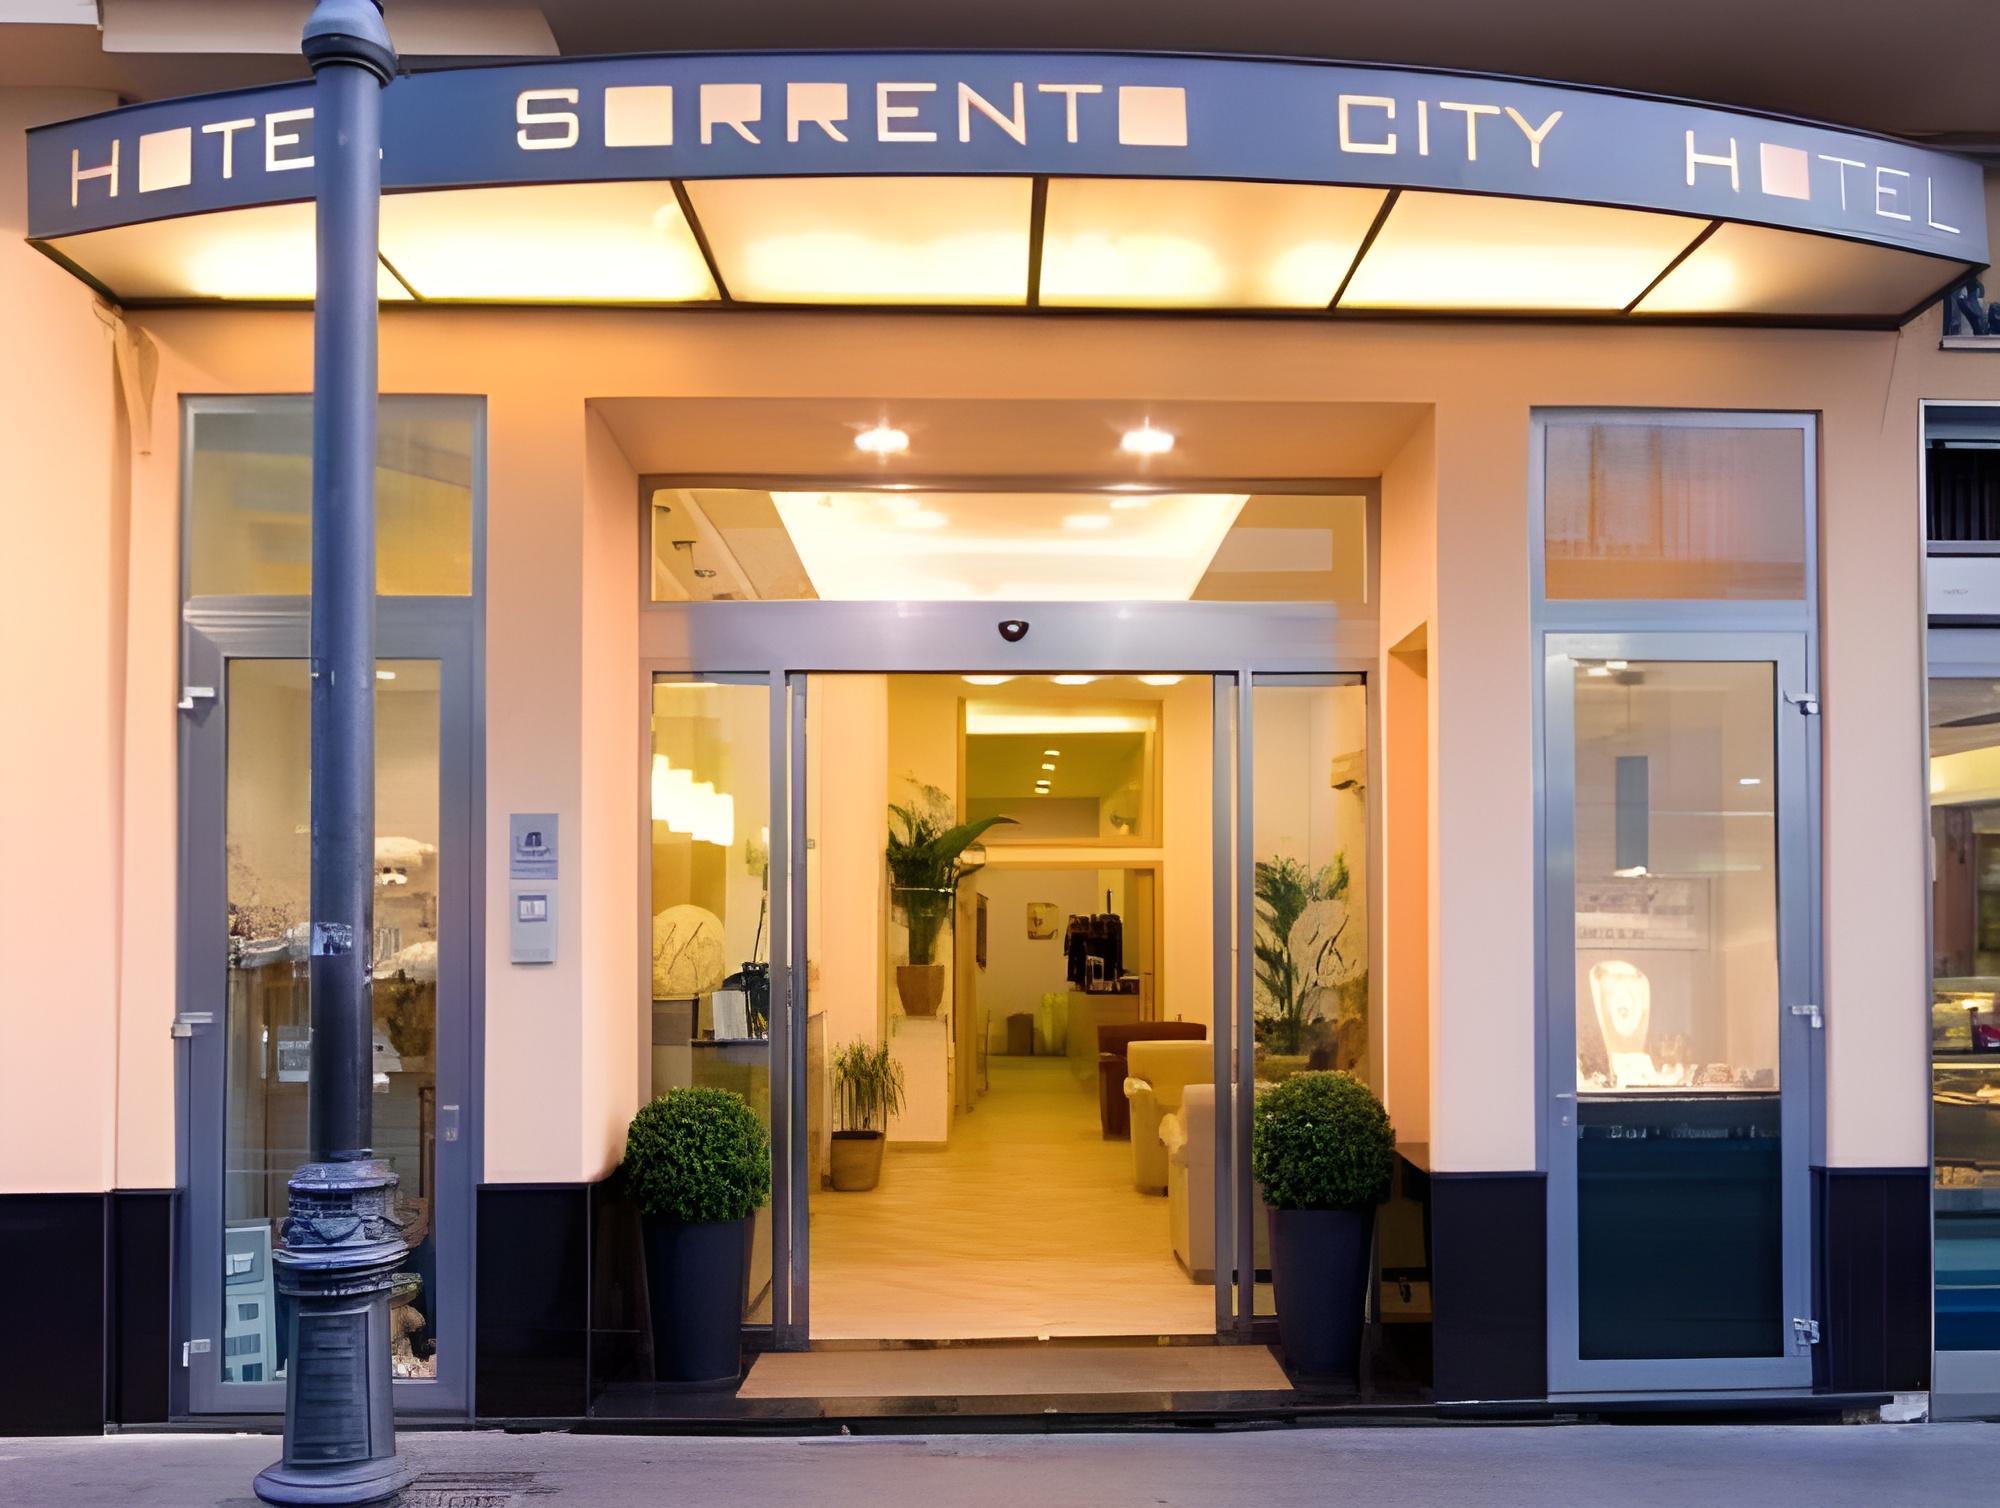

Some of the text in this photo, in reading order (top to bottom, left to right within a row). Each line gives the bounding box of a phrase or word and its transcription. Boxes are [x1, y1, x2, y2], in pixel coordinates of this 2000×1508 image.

[71, 81, 1961, 234] HOTE SORRENTO CITY HOTEL
